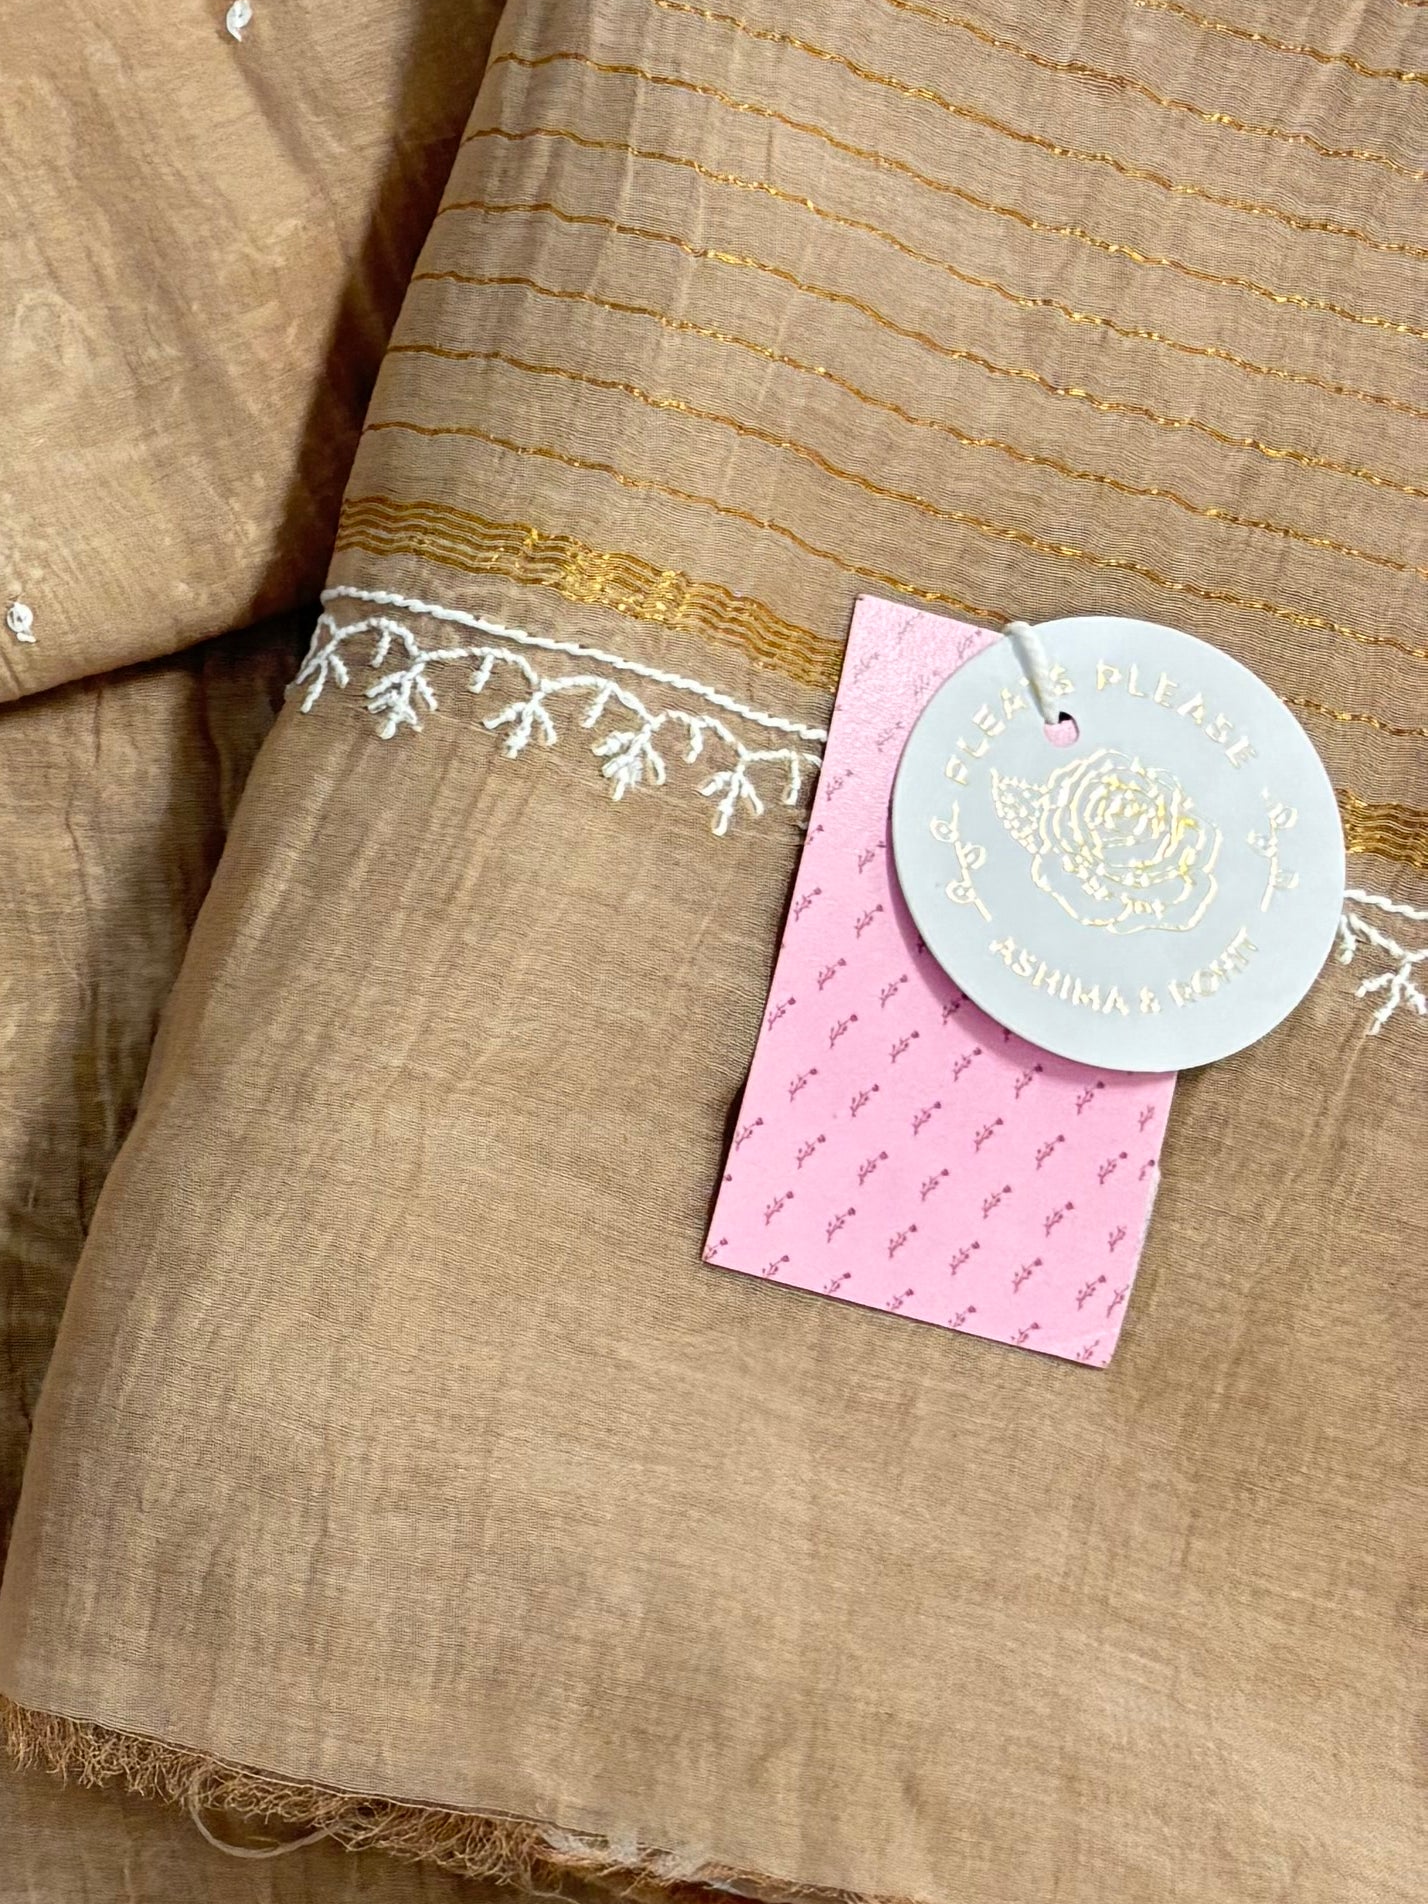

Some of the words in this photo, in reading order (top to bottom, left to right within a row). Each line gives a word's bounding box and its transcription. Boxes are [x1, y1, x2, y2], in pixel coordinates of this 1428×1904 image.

[945, 664, 1075, 785] PLEAS
[1096, 660, 1257, 769] PLEASE
[988, 937, 1129, 1016] ASHIMA
[1139, 986, 1162, 1014] &
